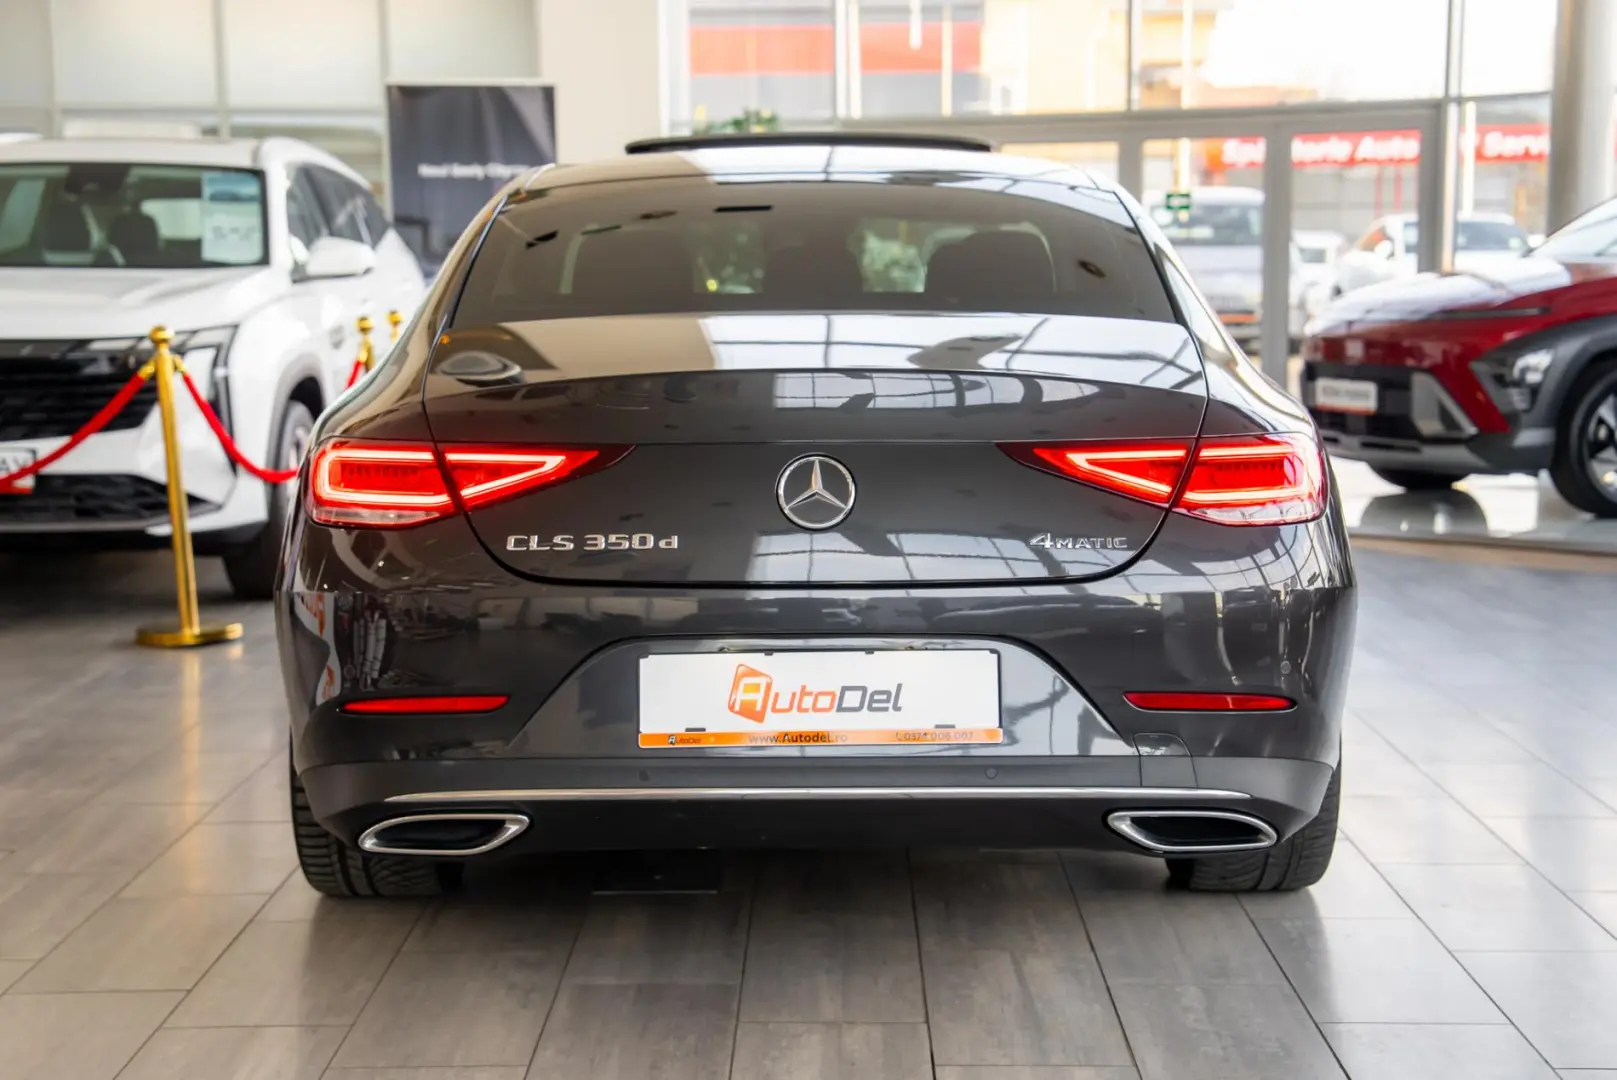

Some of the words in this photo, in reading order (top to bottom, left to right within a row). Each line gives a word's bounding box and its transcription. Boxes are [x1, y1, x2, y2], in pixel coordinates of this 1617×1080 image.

[506, 534, 574, 551] CLS
[1029, 532, 1128, 549] 4MATIC
[730, 672, 903, 716] AutoDel
[748, 731, 848, 744] www.Autodel.ro
[930, 731, 951, 741] 006
